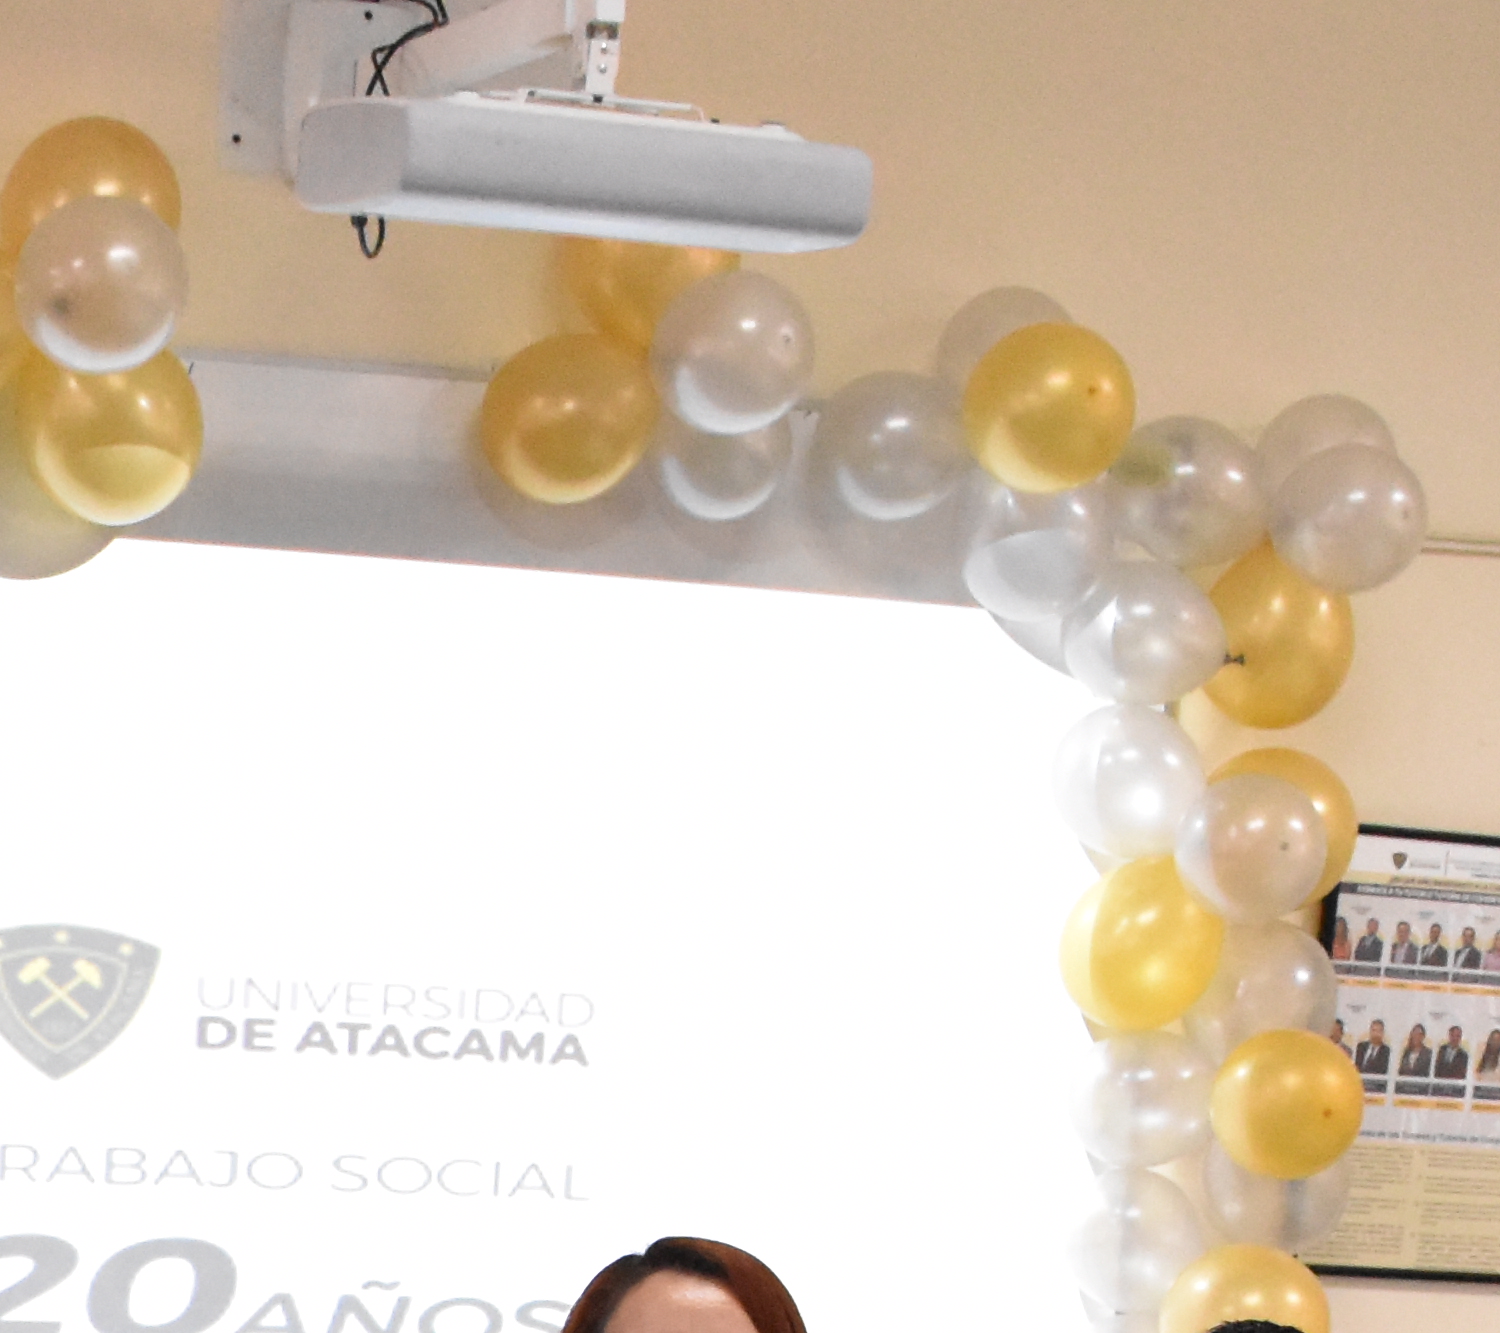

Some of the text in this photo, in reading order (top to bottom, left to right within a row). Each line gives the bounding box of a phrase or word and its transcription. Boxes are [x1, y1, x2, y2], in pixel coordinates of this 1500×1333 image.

[198, 977, 596, 1028] UNIVERSIDAD
[196, 1015, 590, 1067] DE ATACAMA
[330, 1152, 591, 1201] SOCIAL
